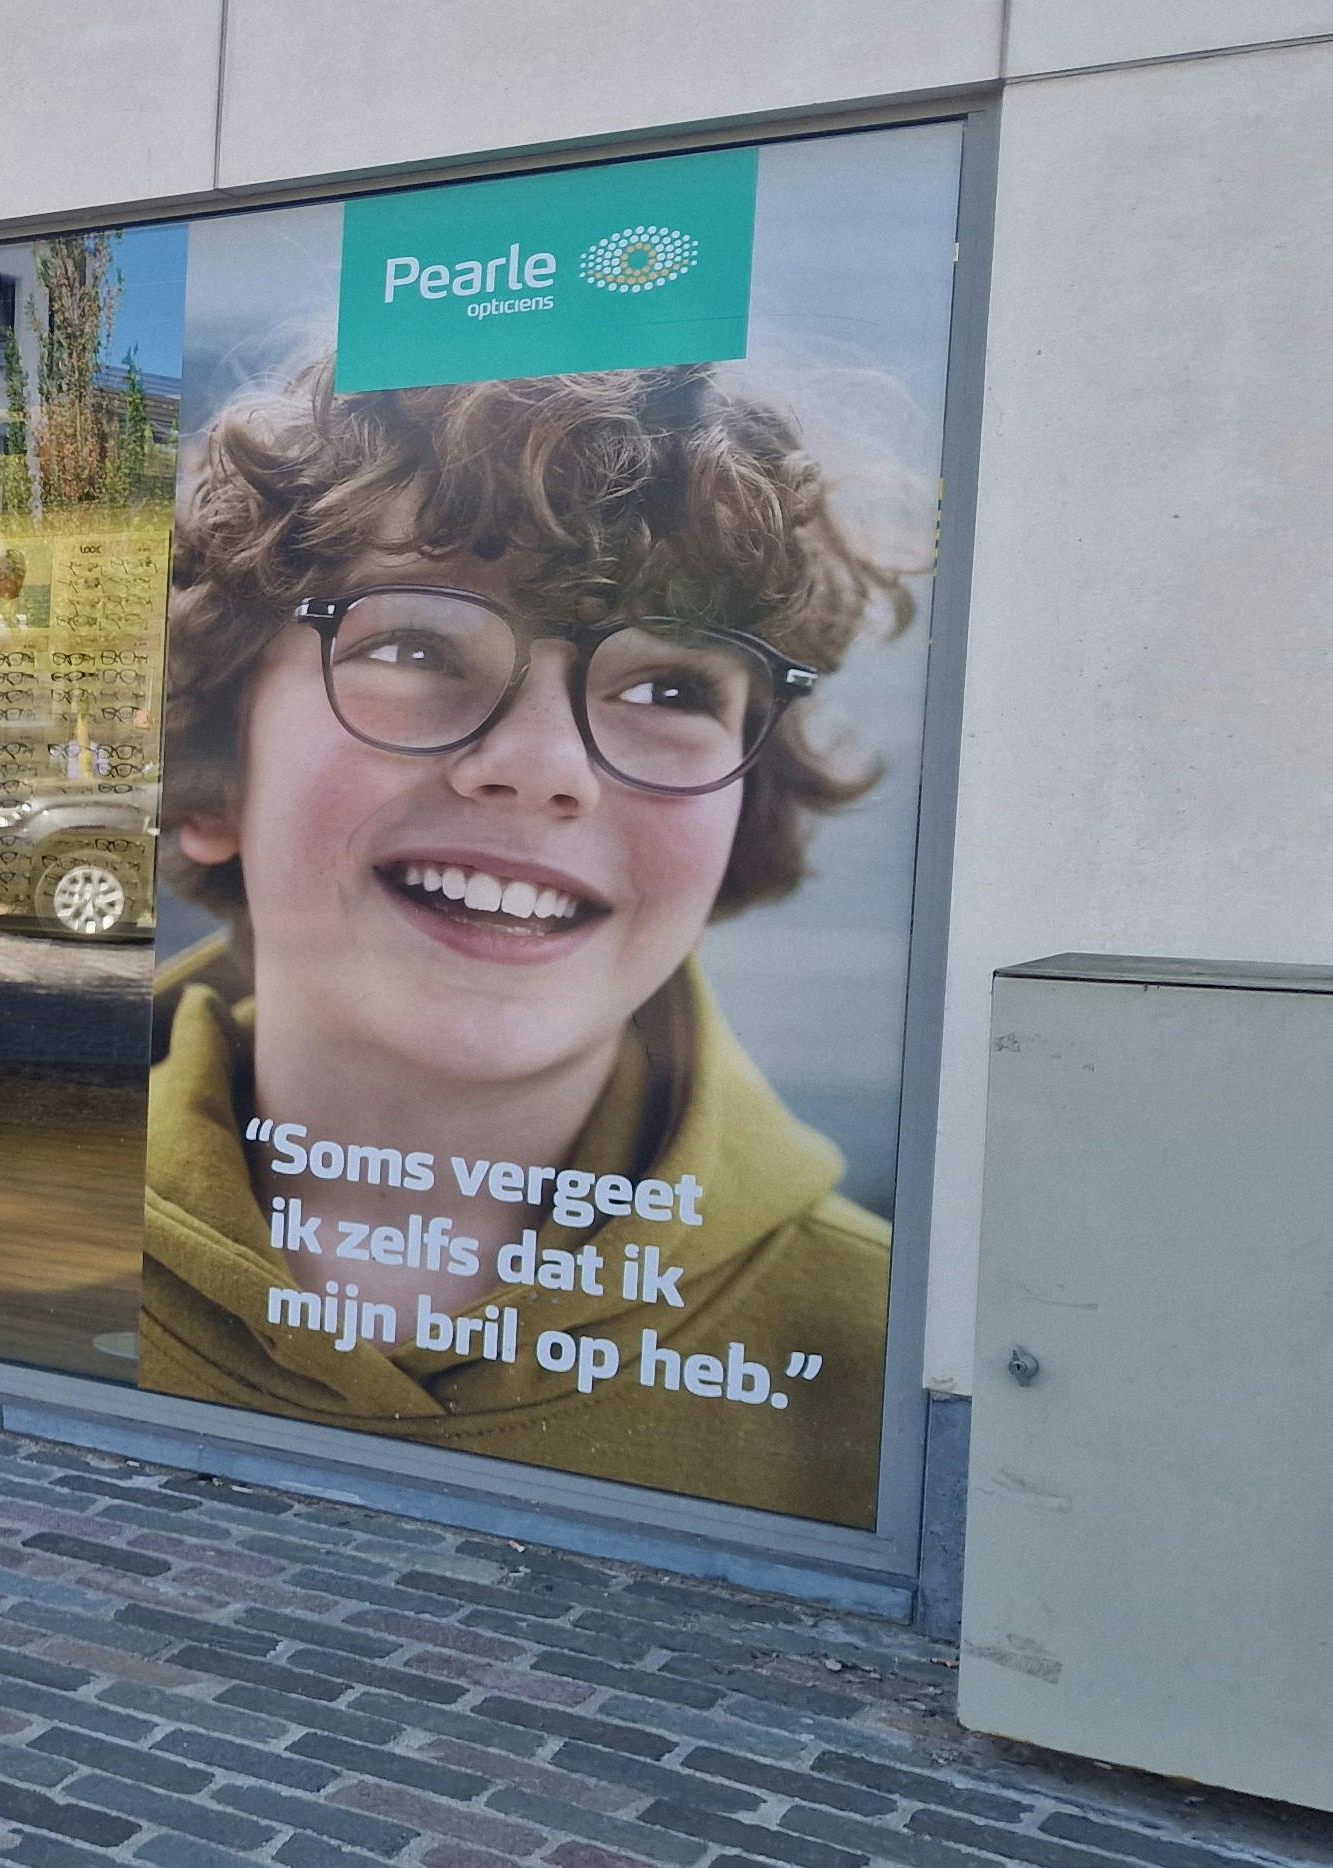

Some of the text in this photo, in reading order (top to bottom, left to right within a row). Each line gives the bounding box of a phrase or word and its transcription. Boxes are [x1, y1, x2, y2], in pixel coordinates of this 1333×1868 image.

[385, 242, 556, 304] Pearle
[467, 295, 554, 320] opticiens
[245, 1117, 703, 1228] “Soms vergeet
[269, 1197, 685, 1308] ik zelfs dat ik
[267, 1281, 823, 1410] mijn bril op heb.”
